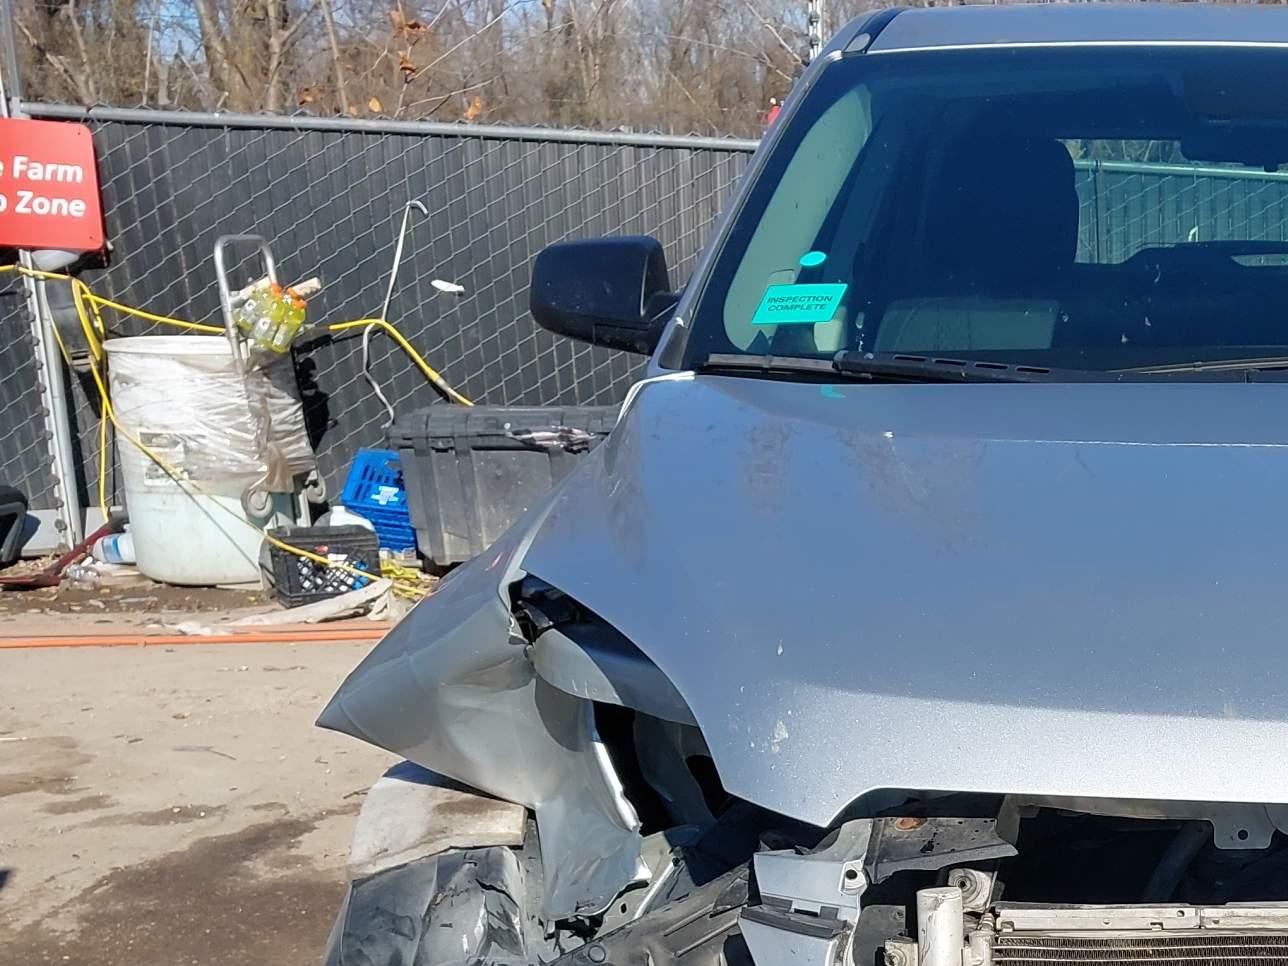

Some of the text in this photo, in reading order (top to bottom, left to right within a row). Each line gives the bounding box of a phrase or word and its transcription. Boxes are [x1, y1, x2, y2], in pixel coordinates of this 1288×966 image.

[13, 156, 83, 184] Farm
[15, 191, 86, 217] Zone
[766, 295, 833, 303] INSPECTION
[767, 303, 826, 312] COMPLETE
